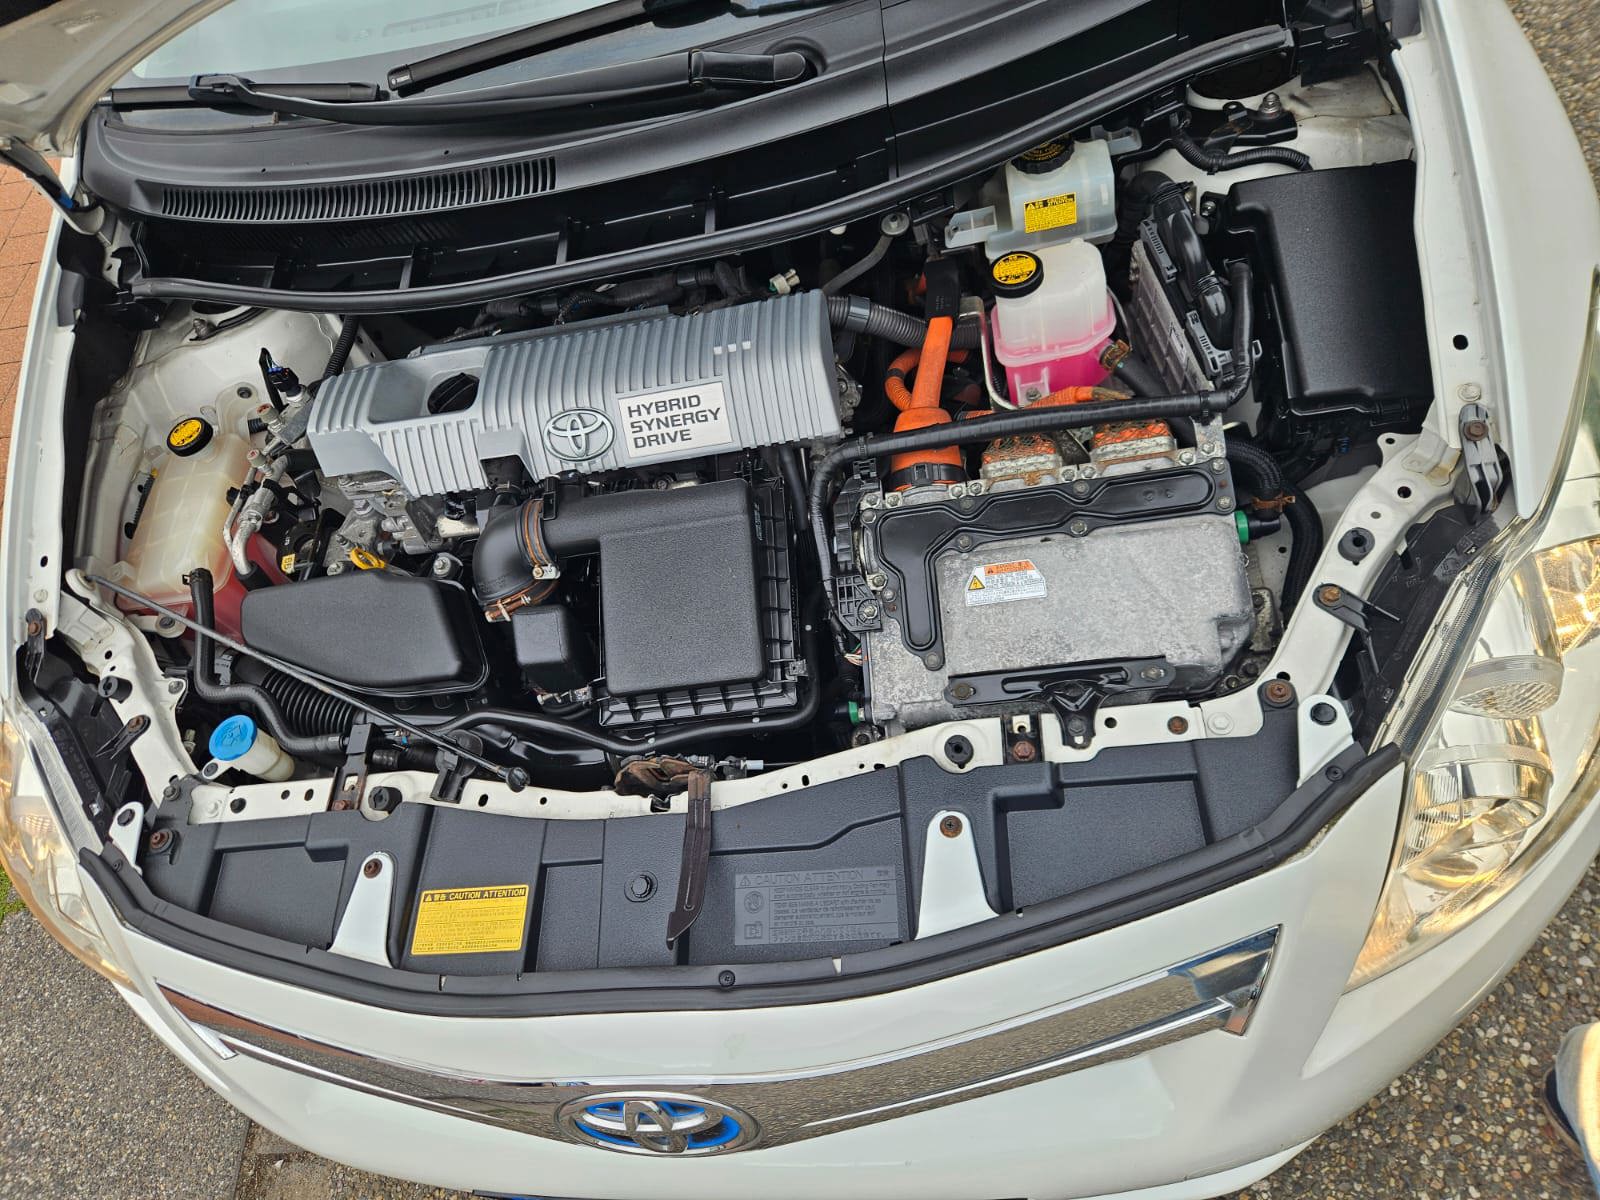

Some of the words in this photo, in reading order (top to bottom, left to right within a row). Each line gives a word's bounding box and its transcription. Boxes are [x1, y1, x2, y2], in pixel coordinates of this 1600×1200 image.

[627, 395, 701, 418] HYBRID
[630, 407, 721, 433] SYNERGY
[633, 429, 692, 448] DRIVE
[449, 892, 480, 900] CAUTION
[483, 889, 525, 898] ATTENTION
